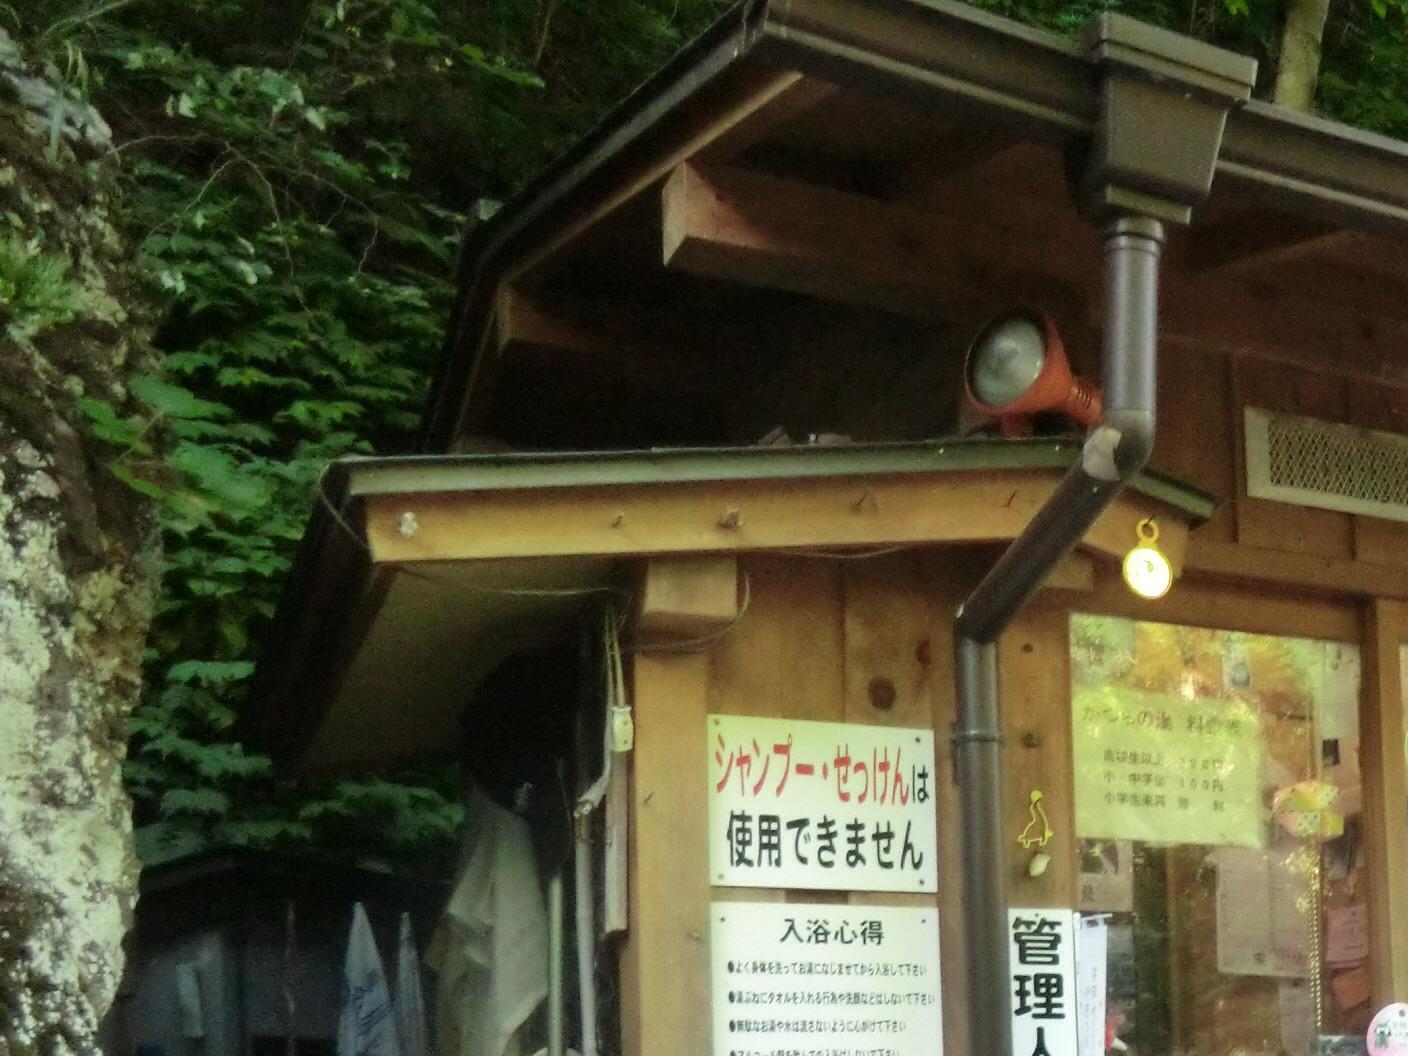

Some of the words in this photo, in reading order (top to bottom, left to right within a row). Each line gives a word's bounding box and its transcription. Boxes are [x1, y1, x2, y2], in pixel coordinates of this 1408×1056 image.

[716, 733, 930, 806] シャンプー・せっけんは
[727, 810, 924, 870] 使用できません
[780, 918, 885, 946] 入浴心得
